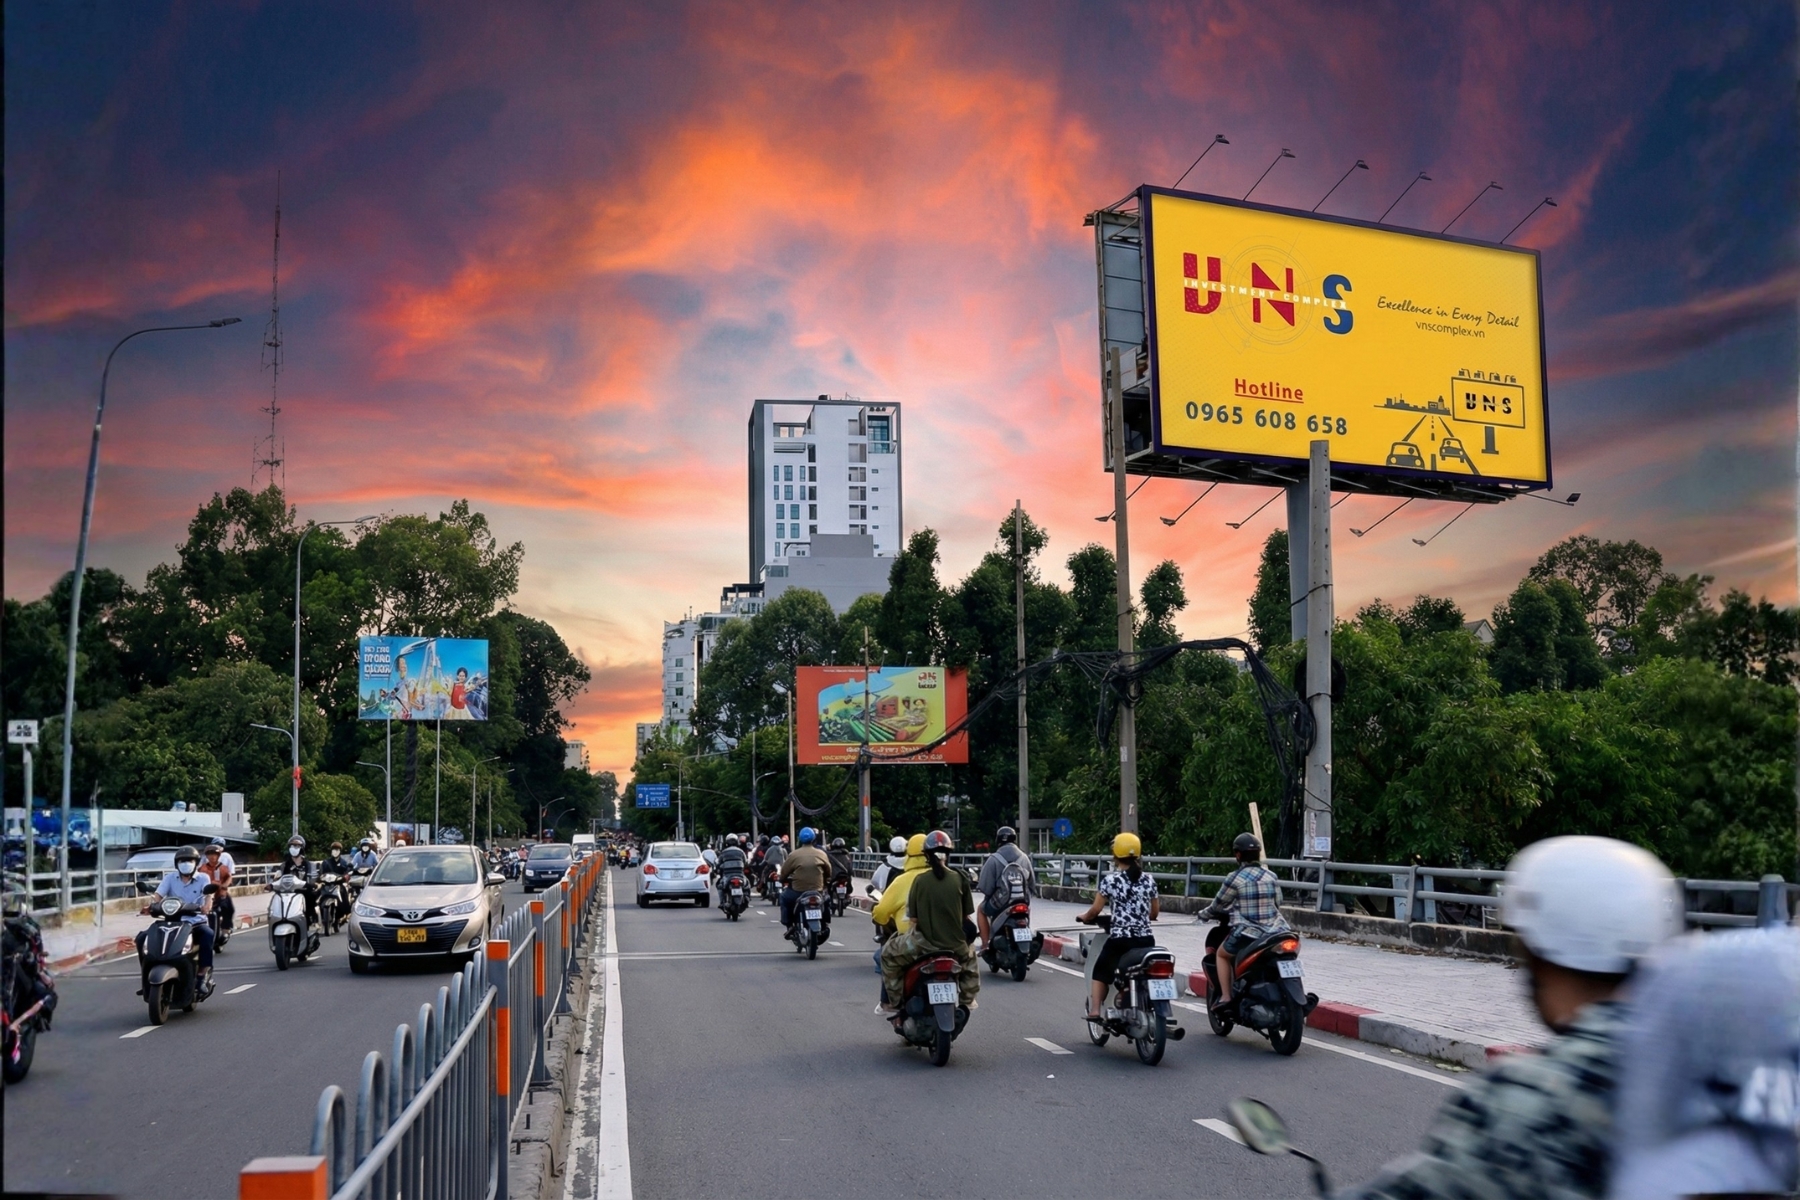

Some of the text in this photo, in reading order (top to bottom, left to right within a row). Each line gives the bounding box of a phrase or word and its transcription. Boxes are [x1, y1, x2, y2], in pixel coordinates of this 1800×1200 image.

[1184, 279, 1347, 310] INVESTMENT COMPLEX
[1377, 296, 1519, 328] Excellence in Every Detail
[1415, 321, 1485, 338] vnscomplex.vn
[1234, 378, 1304, 401] Hotline
[1185, 401, 1347, 435] 0965 608 658
